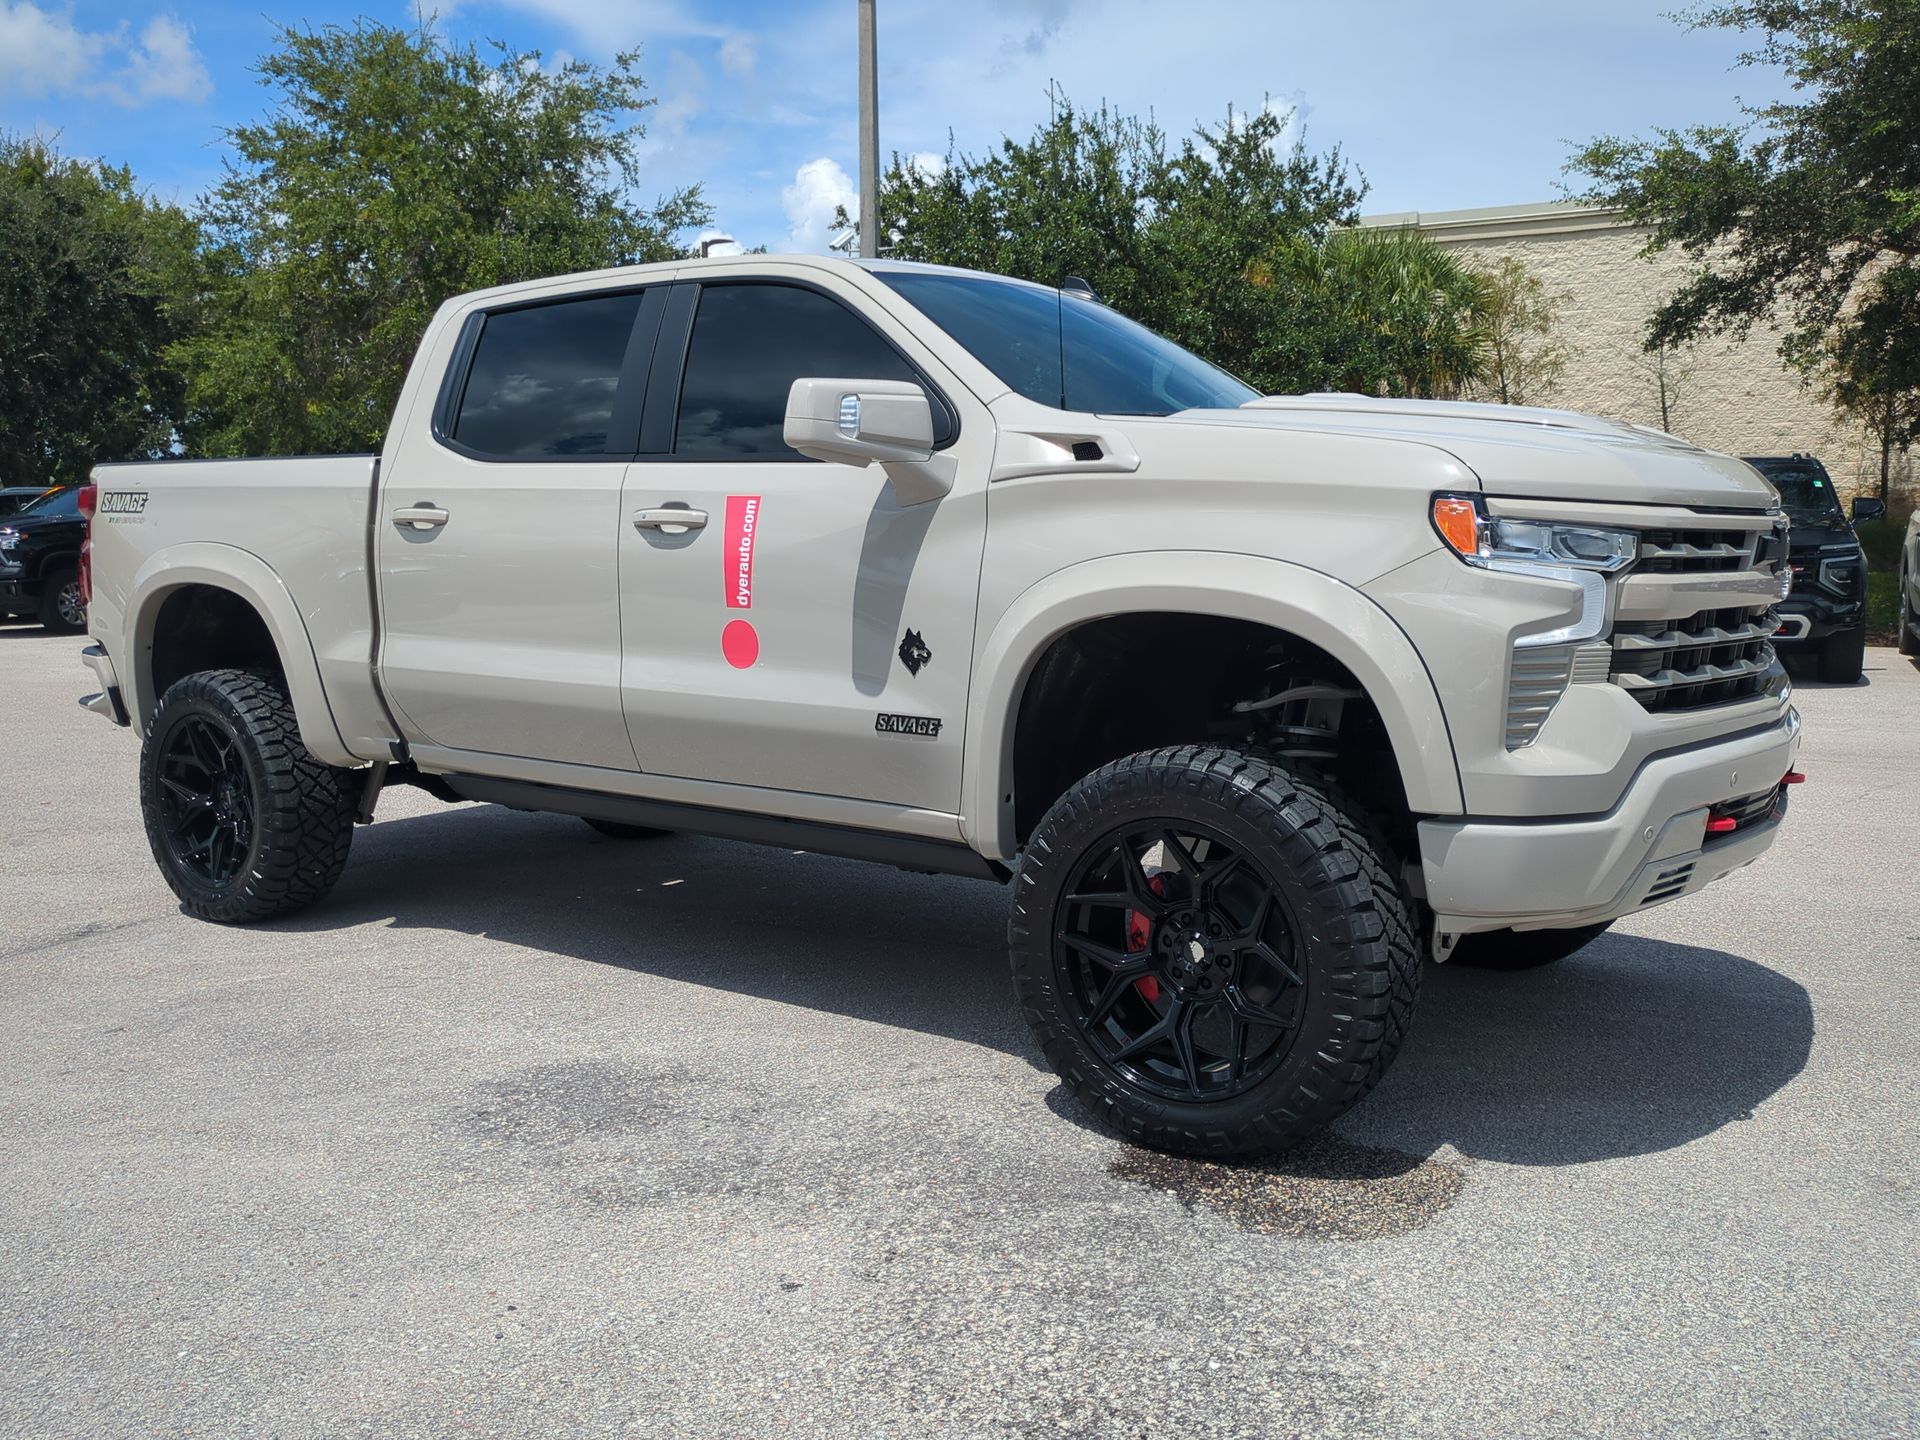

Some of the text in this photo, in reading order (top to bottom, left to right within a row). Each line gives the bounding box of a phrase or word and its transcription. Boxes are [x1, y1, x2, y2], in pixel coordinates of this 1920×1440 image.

[101, 492, 149, 513] SAVAGE
[736, 499, 757, 606] dyerauto.com
[875, 713, 943, 737] SAVAGE
